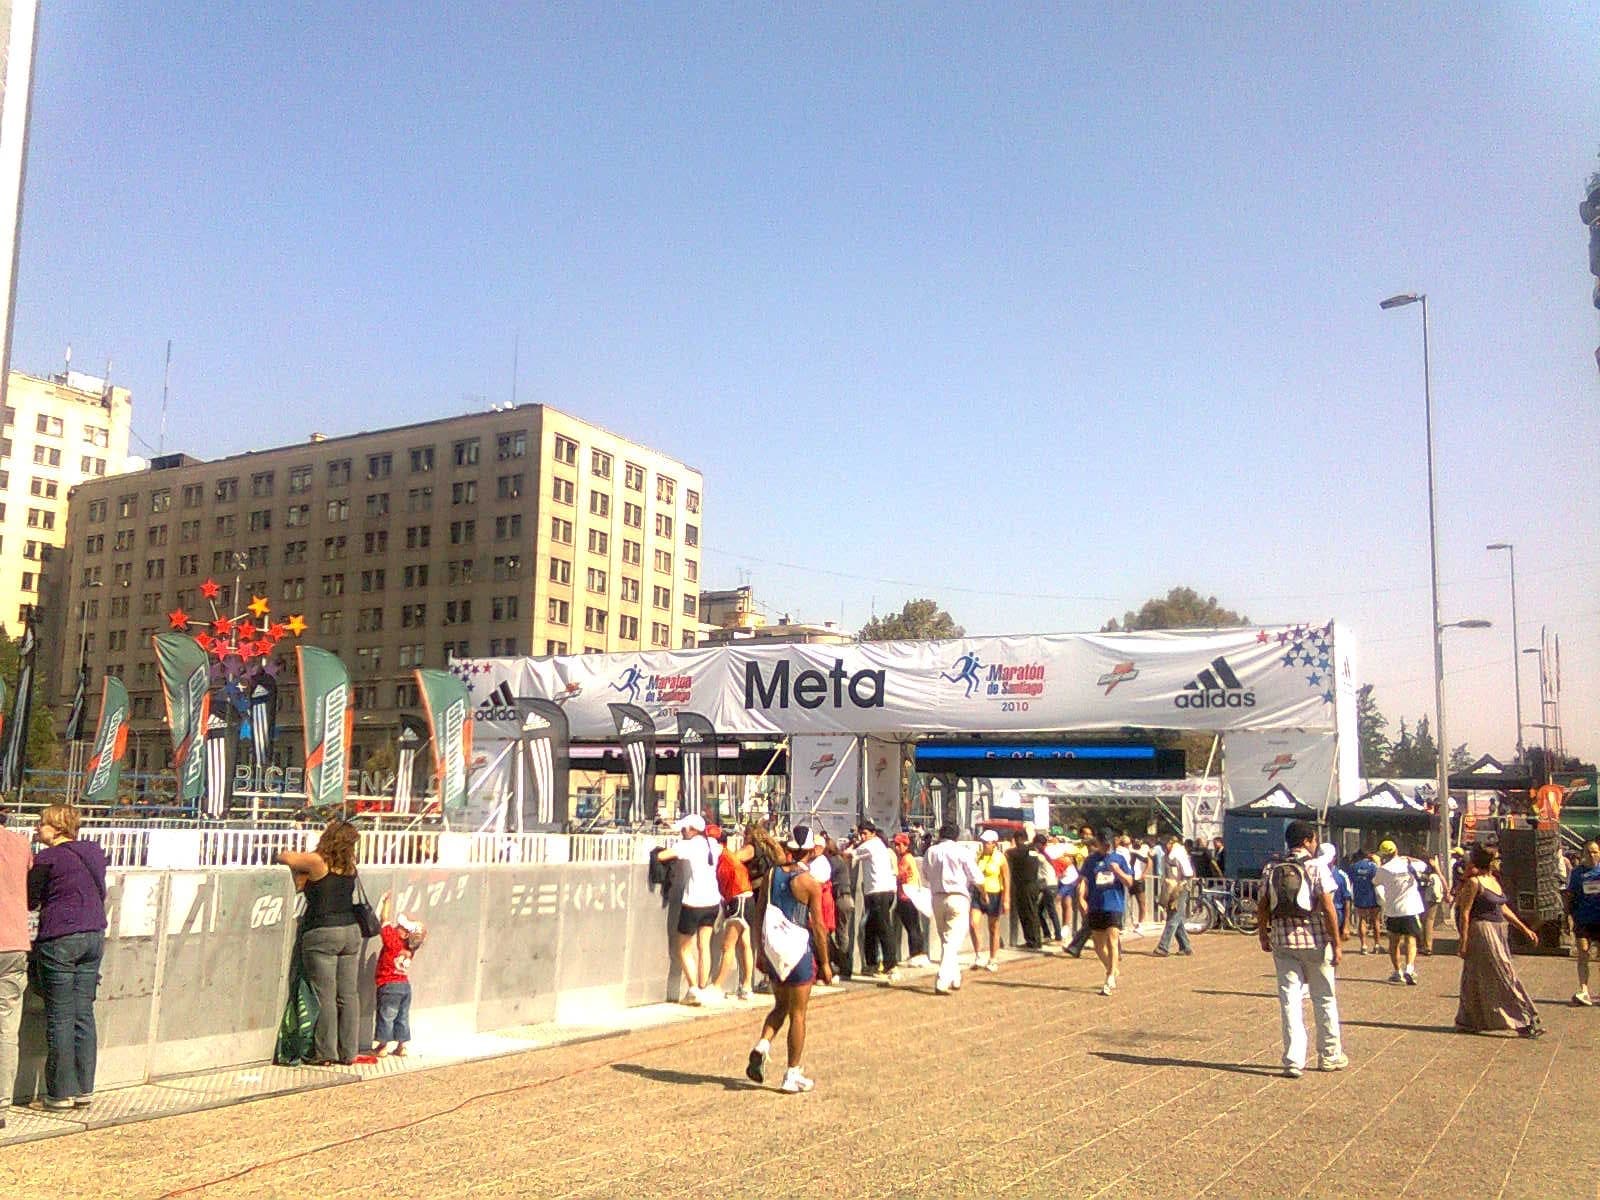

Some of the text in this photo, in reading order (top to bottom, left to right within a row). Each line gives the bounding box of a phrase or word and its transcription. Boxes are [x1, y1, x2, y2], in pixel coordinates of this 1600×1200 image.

[986, 661, 1044, 681] Maratón
[744, 658, 886, 710] Meta
[986, 681, 1043, 696] de Santiago
[1001, 701, 1029, 712] 2010
[1173, 687, 1256, 709] adidas
